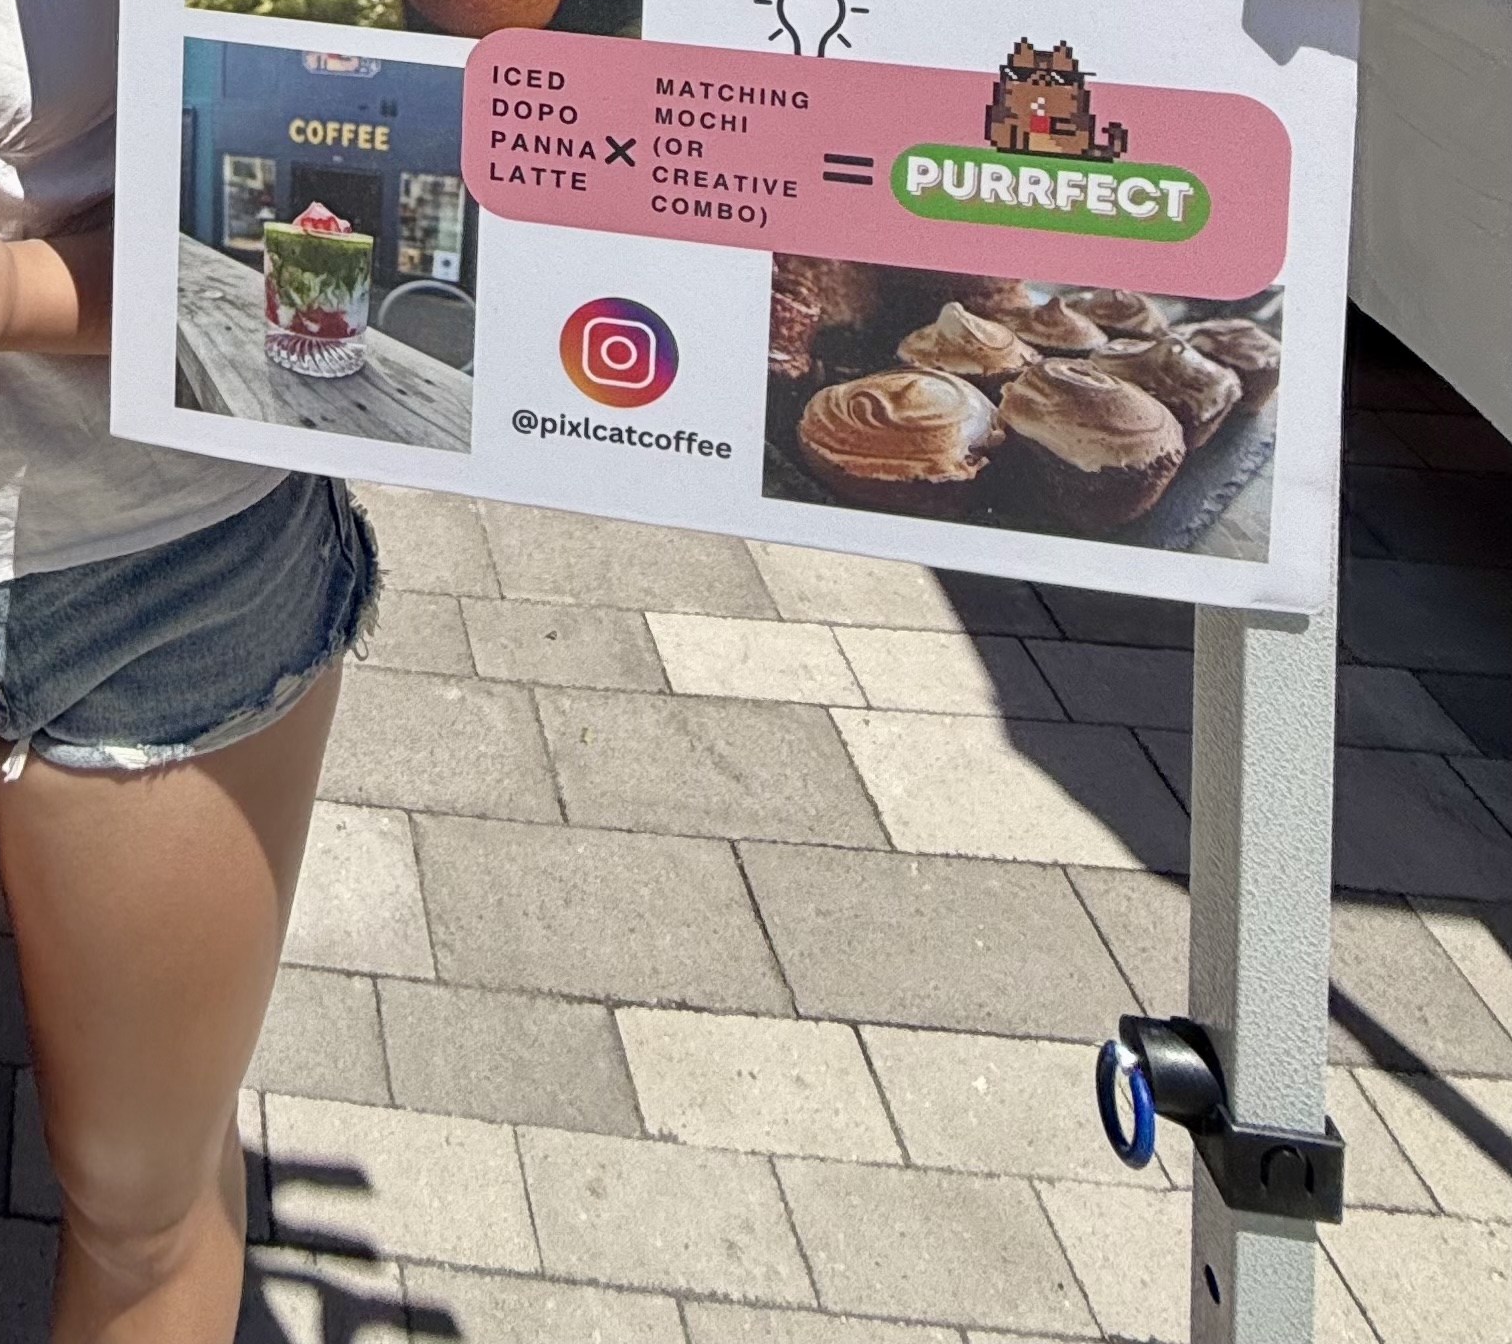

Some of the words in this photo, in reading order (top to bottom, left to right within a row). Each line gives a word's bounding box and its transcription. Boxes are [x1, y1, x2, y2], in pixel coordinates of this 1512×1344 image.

[492, 65, 565, 91] ICED
[655, 77, 809, 110] MATCHING
[492, 97, 578, 125] DOPO
[655, 106, 748, 134] MOCHI
[288, 118, 390, 151] COFFEE
[490, 130, 597, 161] PANNA
[653, 135, 703, 159] (OR
[489, 161, 587, 192] LATTE
[651, 165, 798, 199] CREATIVE
[906, 157, 1193, 223] PURRFECT
[651, 194, 768, 229] COMBO)
[511, 409, 732, 460] @pixlcatcoffee
